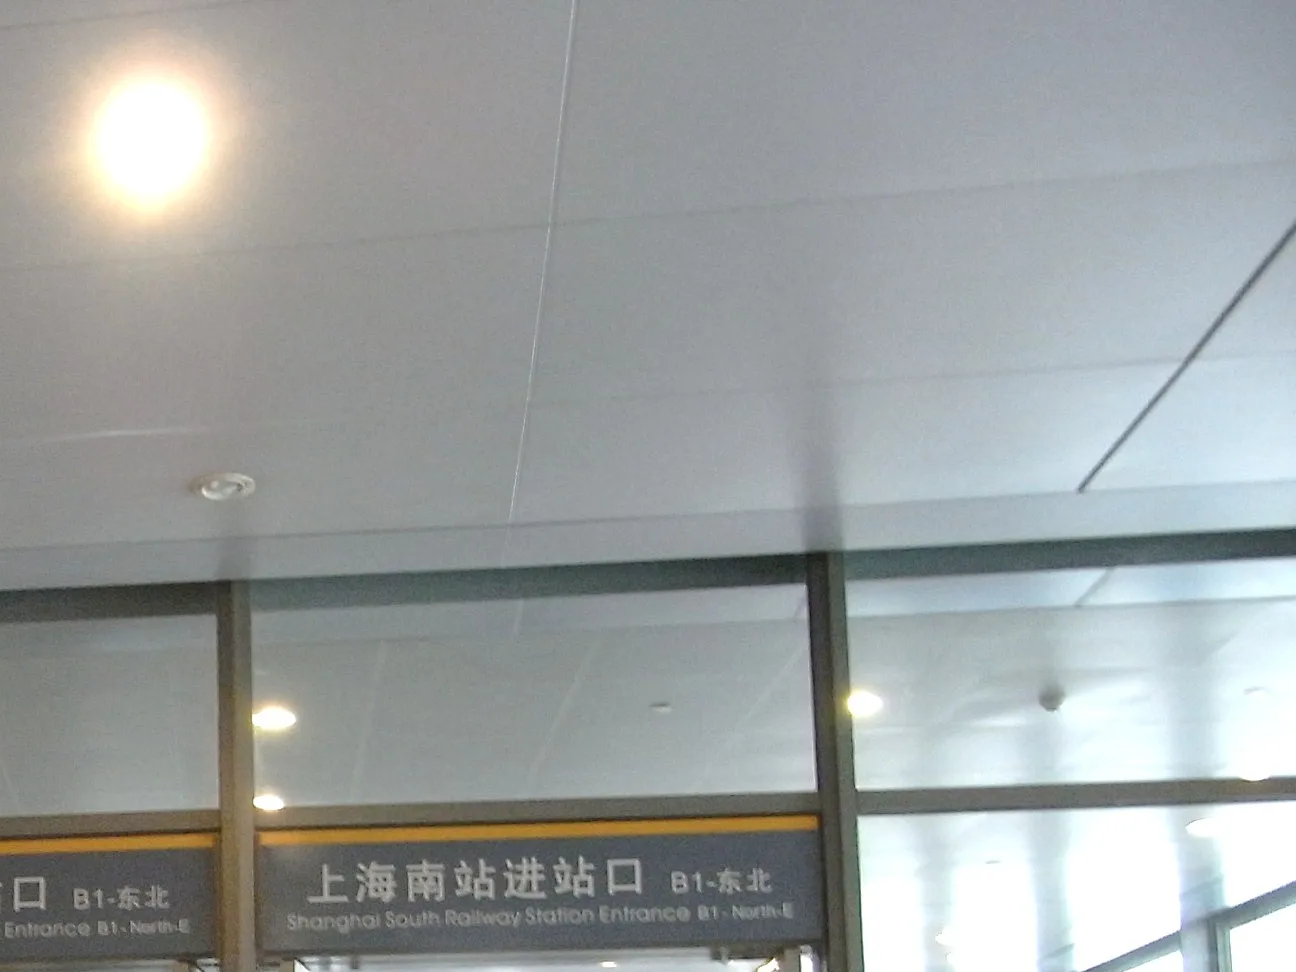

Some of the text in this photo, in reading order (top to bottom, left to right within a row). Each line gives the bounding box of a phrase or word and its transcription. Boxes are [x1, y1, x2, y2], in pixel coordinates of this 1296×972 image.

[307, 856, 773, 904] 上海南站进站口 B1-东北
[73, 885, 170, 911] B1-东北
[5, 920, 91, 939] Entrance
[287, 911, 381, 934] Shanghai
[385, 910, 440, 929] South
[445, 908, 520, 928] Railway
[525, 907, 594, 926] Station
[599, 904, 691, 924] Entrance
